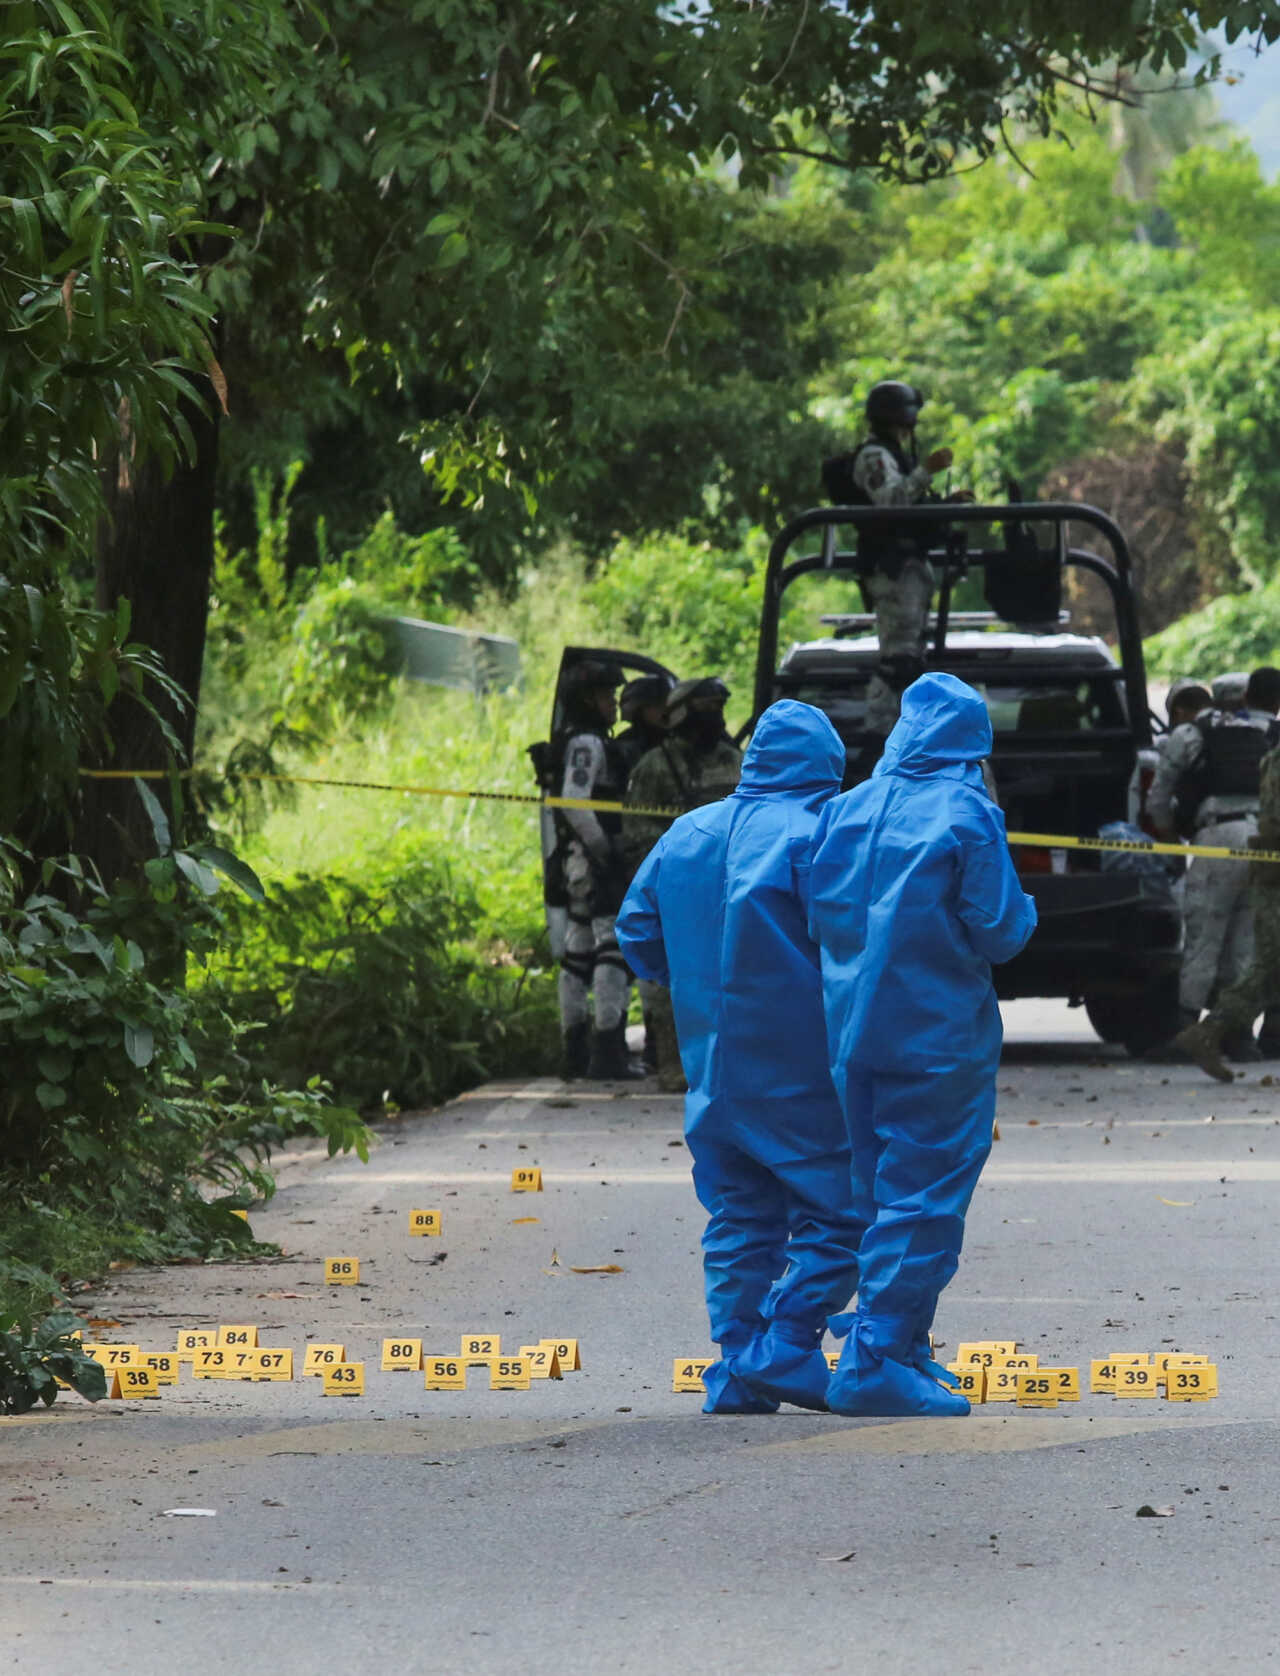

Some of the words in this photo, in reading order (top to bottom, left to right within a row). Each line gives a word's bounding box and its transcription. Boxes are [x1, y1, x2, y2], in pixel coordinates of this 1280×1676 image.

[518, 1172, 534, 1182] 91
[415, 1215, 434, 1225] 88
[331, 1262, 351, 1274] 86
[226, 1332, 248, 1344] 84
[390, 1344, 413, 1358] 80
[469, 1341, 492, 1353] 82
[108, 1351, 130, 1364] 75
[201, 1352, 224, 1365] 73
[260, 1354, 284, 1368] 67
[313, 1350, 334, 1363] 76
[526, 1352, 546, 1365] 72
[148, 1358, 170, 1371] 58
[434, 1363, 458, 1376] 56
[498, 1363, 522, 1376] 55
[682, 1364, 706, 1378] 47
[126, 1371, 149, 1385] 38
[332, 1368, 356, 1382] 43
[997, 1374, 1018, 1387] 31
[1124, 1371, 1148, 1384] 39
[1177, 1374, 1200, 1388] 33
[1025, 1379, 1050, 1393] 25
